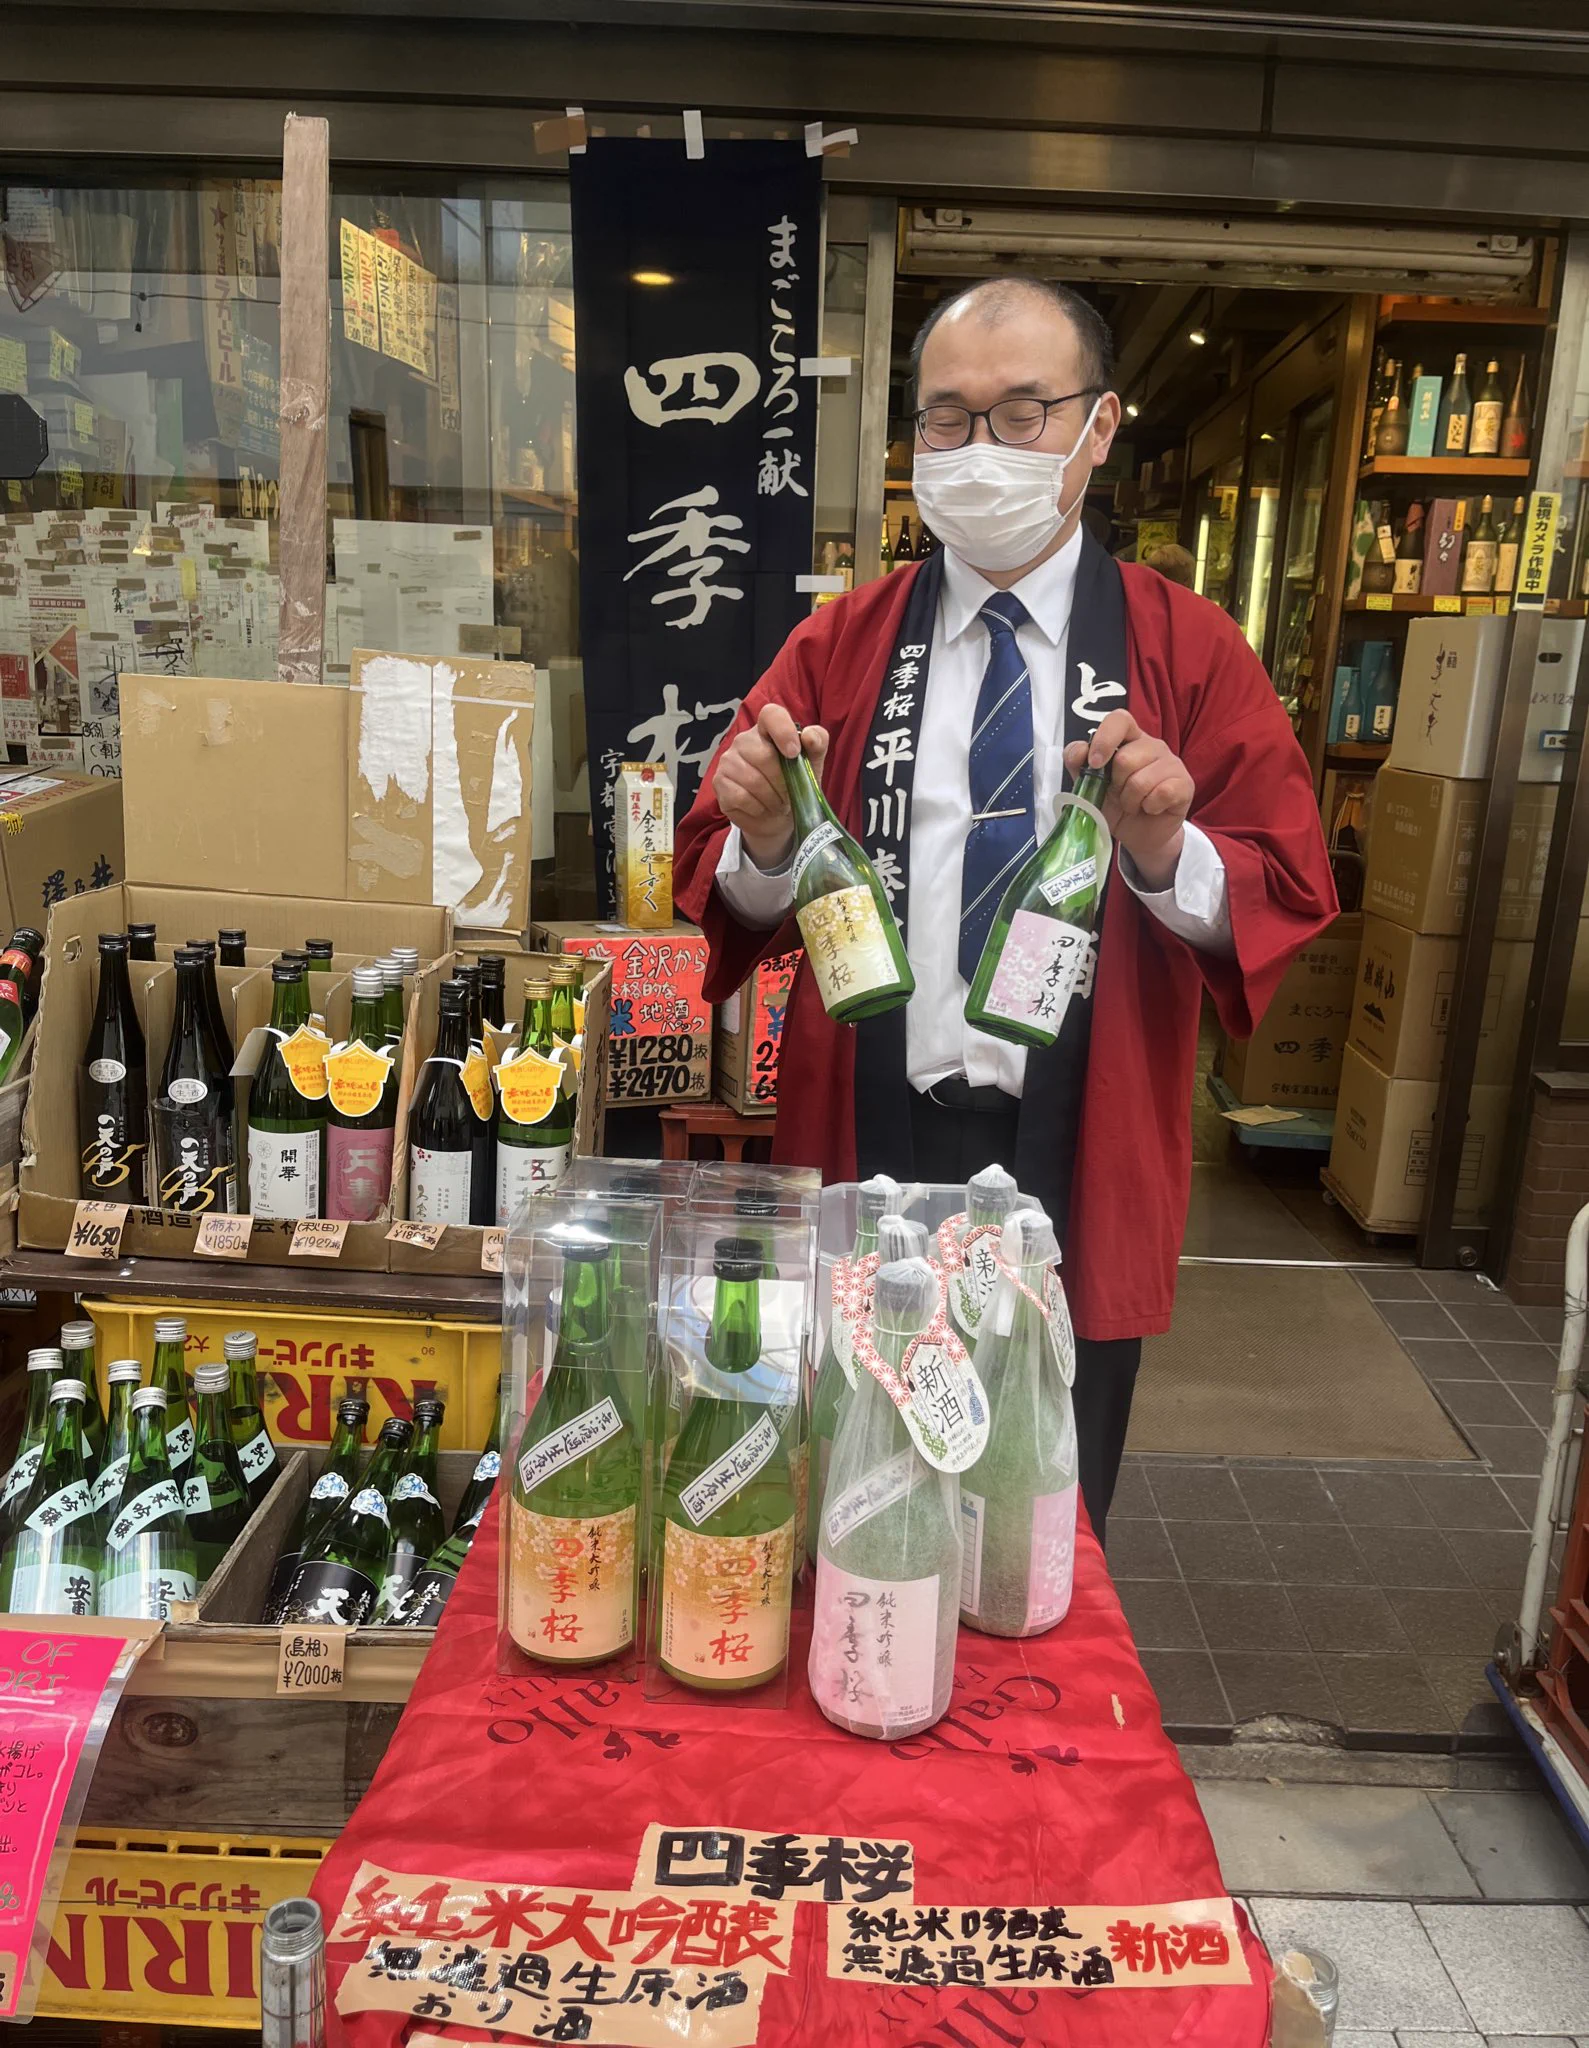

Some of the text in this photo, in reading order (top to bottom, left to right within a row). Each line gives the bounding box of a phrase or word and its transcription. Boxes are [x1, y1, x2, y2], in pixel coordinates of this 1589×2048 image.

[757, 214, 809, 497] まごころ一献
[1524, 495, 1556, 592] 監視カメラ作動中
[882, 643, 927, 721] 四季桜
[622, 940, 708, 979] 金沢から
[811, 911, 856, 992] 四季桜
[1027, 935, 1075, 1019] 四季桜
[640, 999, 690, 1023] 地酒
[661, 1017, 705, 1033] パック
[1288, 1002, 1350, 1019] まごころ一
[1273, 1035, 1343, 1063] 四季
[257, 1338, 375, 1371] キリンビー
[916, 1354, 966, 1434] 新酒
[521, 1410, 615, 1482] 無濾過生原酒
[687, 1425, 772, 1516] 無濾過生原酒
[539, 1537, 585, 1644] 四季桜
[586, 1524, 603, 1592] 純米大吟醸
[760, 1541, 775, 1608] 純米大吟醸
[708, 1555, 758, 1666] 四季桜
[875, 1591, 897, 1668] 純米吟醸
[284, 1636, 329, 1659] (島根)
[655, 1832, 914, 1903] 四季桜
[339, 1873, 790, 1970] 純米大吟醸
[846, 1906, 1083, 1943] 純米吟醸
[1105, 1918, 1231, 1976] 新酒
[364, 1939, 749, 2010] 無濾過生原酒
[842, 1943, 1115, 1987] 無濾過生原酒
